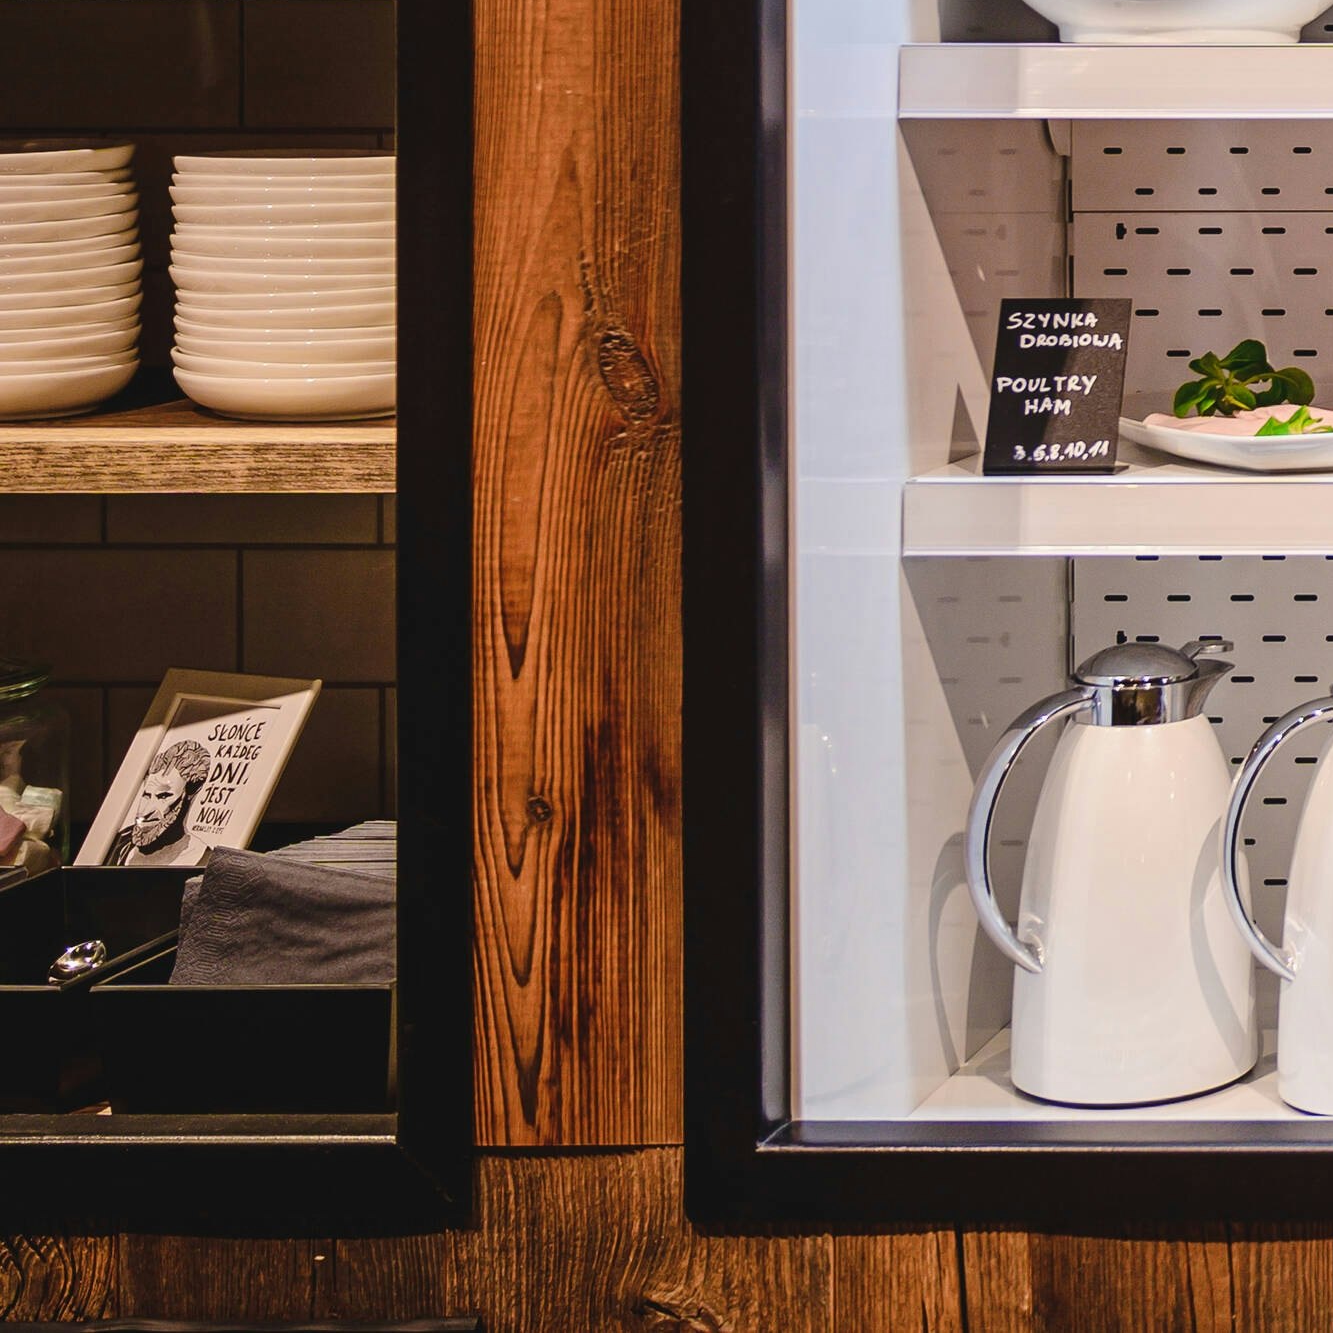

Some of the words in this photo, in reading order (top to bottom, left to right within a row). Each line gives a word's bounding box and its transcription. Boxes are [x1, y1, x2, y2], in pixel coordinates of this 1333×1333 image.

[1006, 312, 1099, 330] SZYNKA
[1019, 333, 1123, 350] DROBIOWA
[997, 375, 1097, 395] POULTRY
[1024, 397, 1071, 416] HAM
[208, 716, 266, 742] SŁOŃCE
[200, 786, 236, 805] JEST
